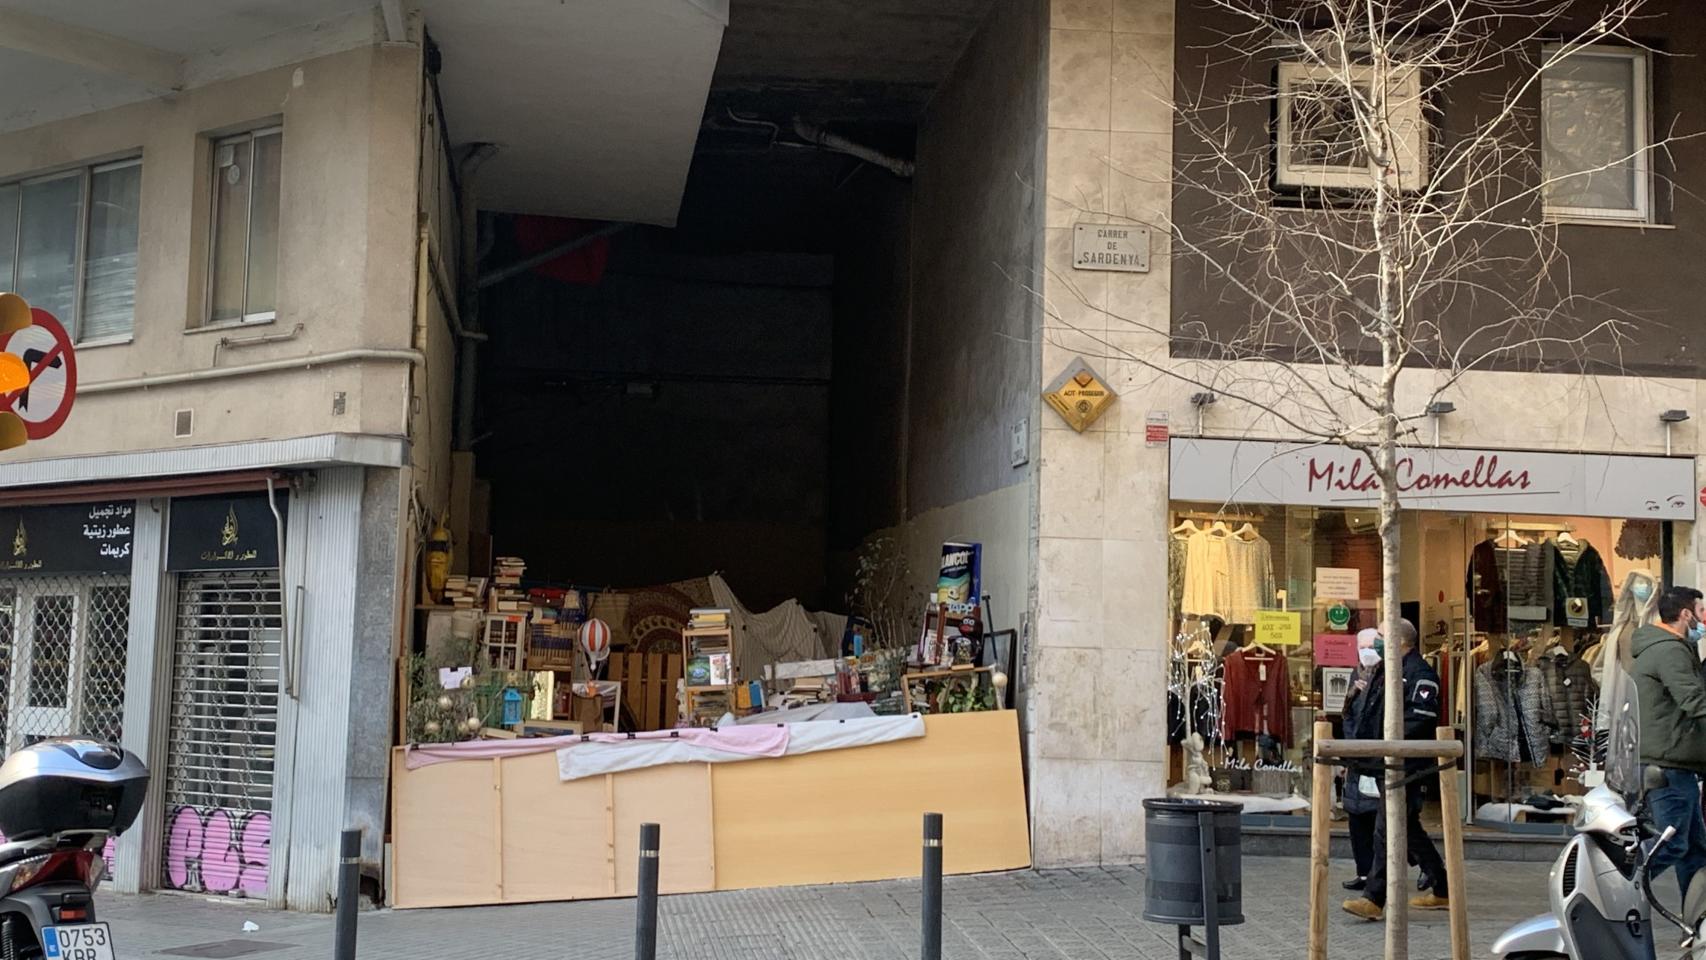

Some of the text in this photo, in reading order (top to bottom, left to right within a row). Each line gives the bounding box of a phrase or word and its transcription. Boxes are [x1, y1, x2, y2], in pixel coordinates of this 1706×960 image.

[1098, 229, 1128, 239] CARRER
[1107, 241, 1118, 250] DE
[1083, 252, 1140, 266] SARDENYA
[1308, 455, 1531, 492] Mila Comellas
[89, 504, 132, 519] مواد تجميل
[106, 523, 131, 538] عطور
[100, 542, 130, 558] كريمات
[1225, 757, 1303, 773] Mila Comellas
[60, 928, 106, 948] 0753
